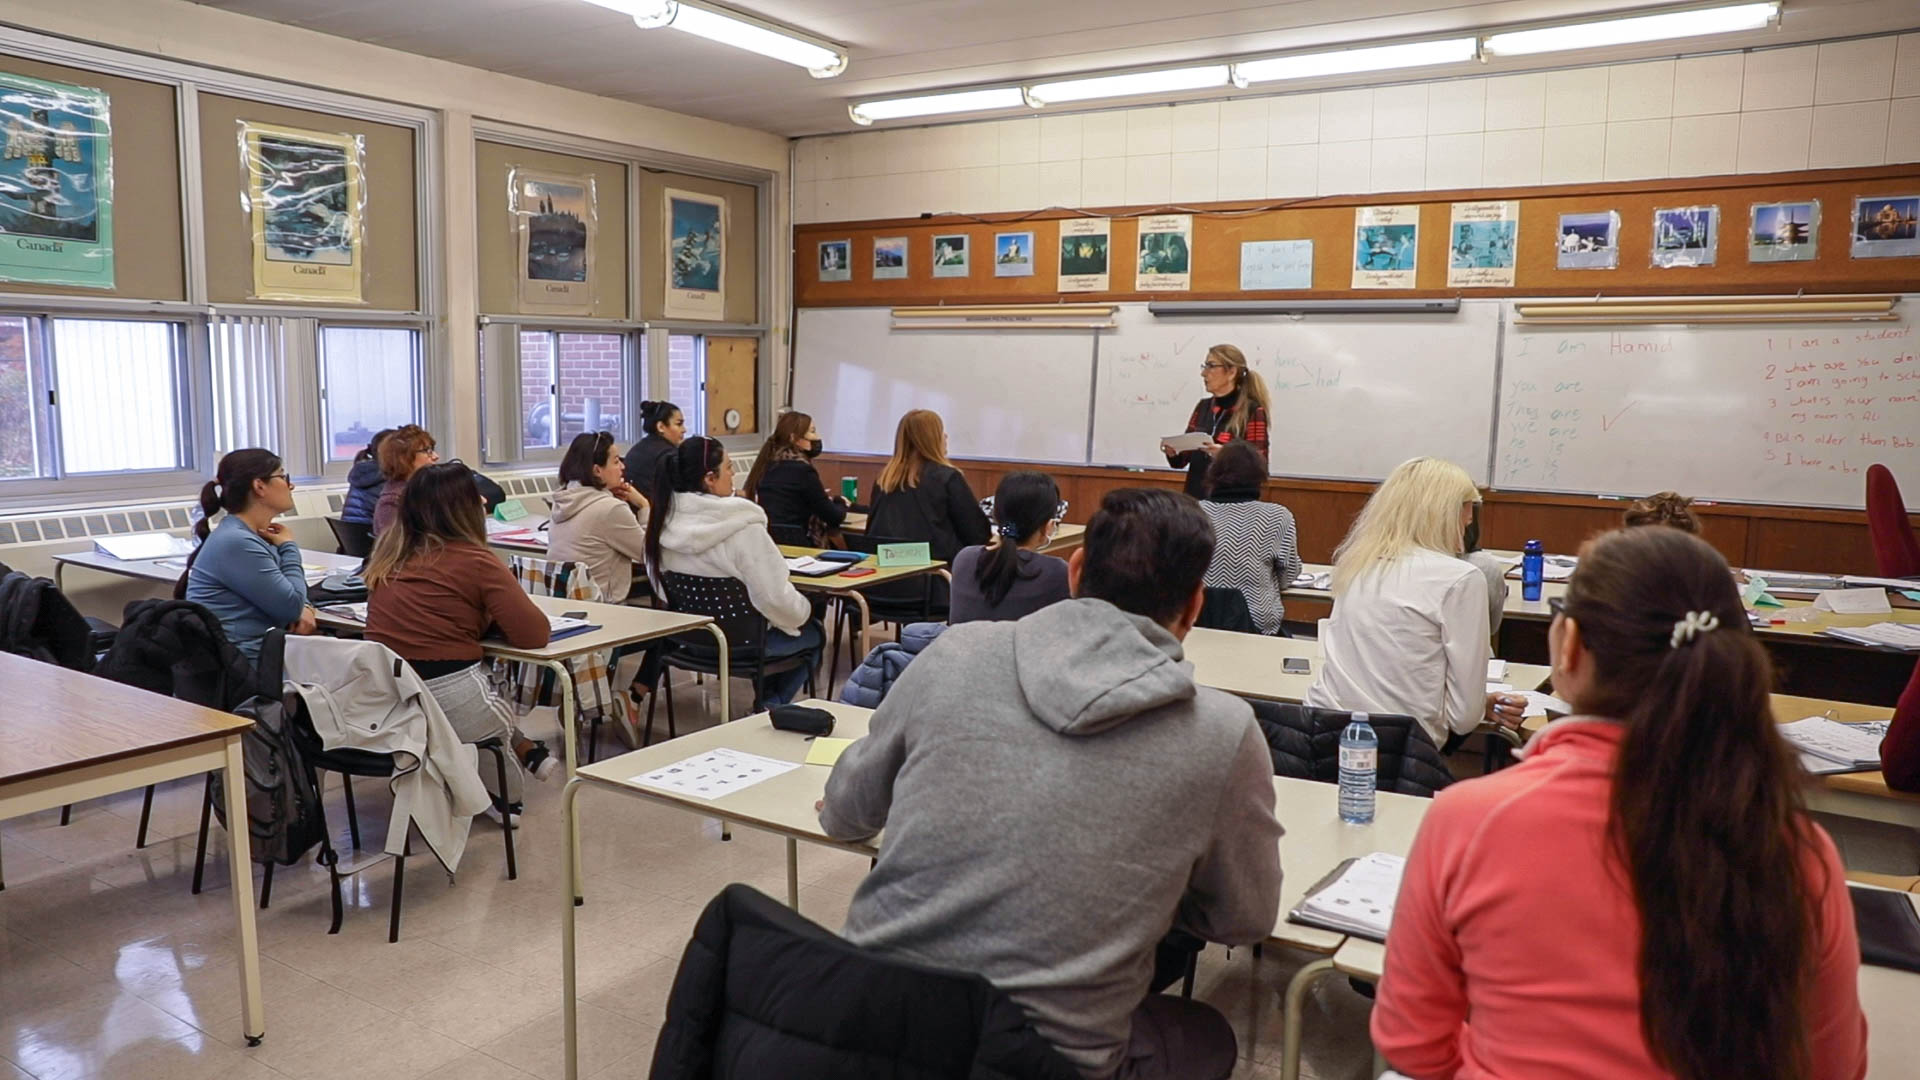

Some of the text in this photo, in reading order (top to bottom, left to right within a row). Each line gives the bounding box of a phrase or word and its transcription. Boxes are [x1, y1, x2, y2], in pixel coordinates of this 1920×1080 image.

[16, 238, 64, 253] Canada
[293, 265, 327, 275] Canada
[1855, 325, 1912, 343] student
[1610, 332, 1673, 355] Hamid
[1765, 364, 1777, 380] 2
[1785, 379, 1793, 391] I
[1796, 379, 1821, 388] am
[1831, 376, 1869, 390] going
[1814, 434, 1847, 445] older
[1784, 452, 1793, 466] I
